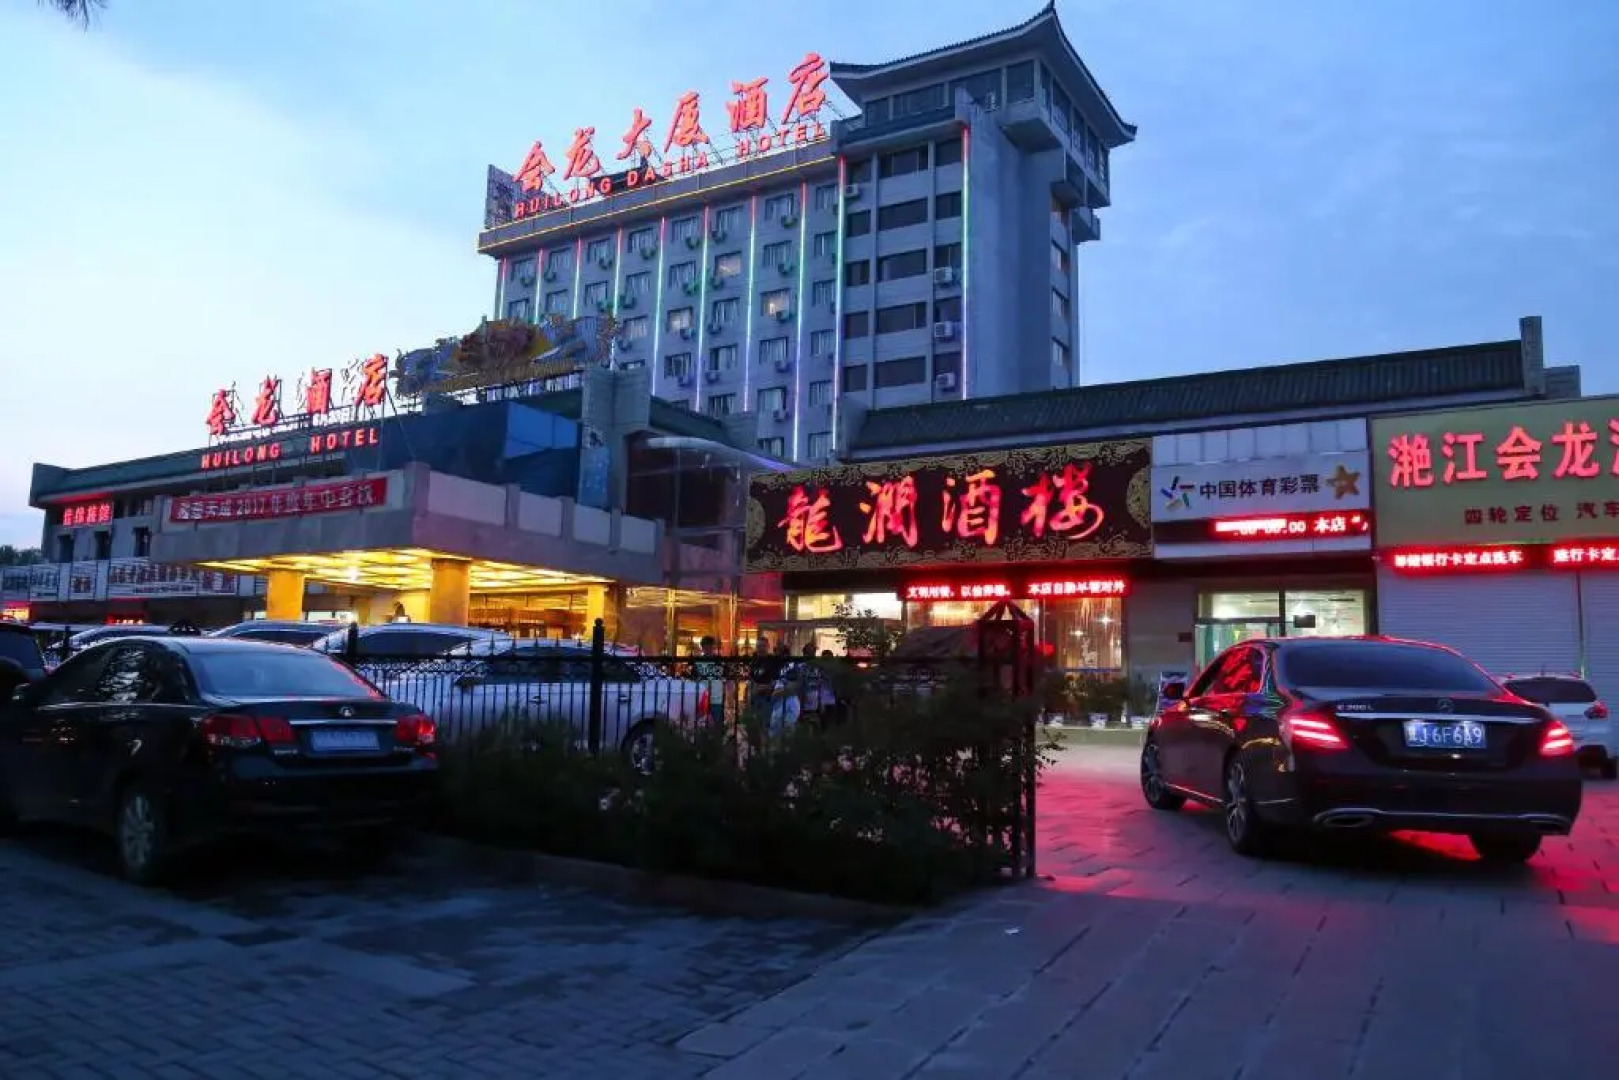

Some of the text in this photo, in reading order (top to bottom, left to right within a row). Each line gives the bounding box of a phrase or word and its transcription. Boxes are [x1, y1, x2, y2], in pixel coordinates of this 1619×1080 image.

[514, 176, 613, 219] HUILONG
[737, 122, 826, 157] HOTEL
[202, 427, 378, 469] HUILONG HOTEL
[1388, 418, 1619, 487] 滟江会龙
[1200, 474, 1320, 499] 中国体育彩票
[1464, 505, 1560, 525] 四轮定位
